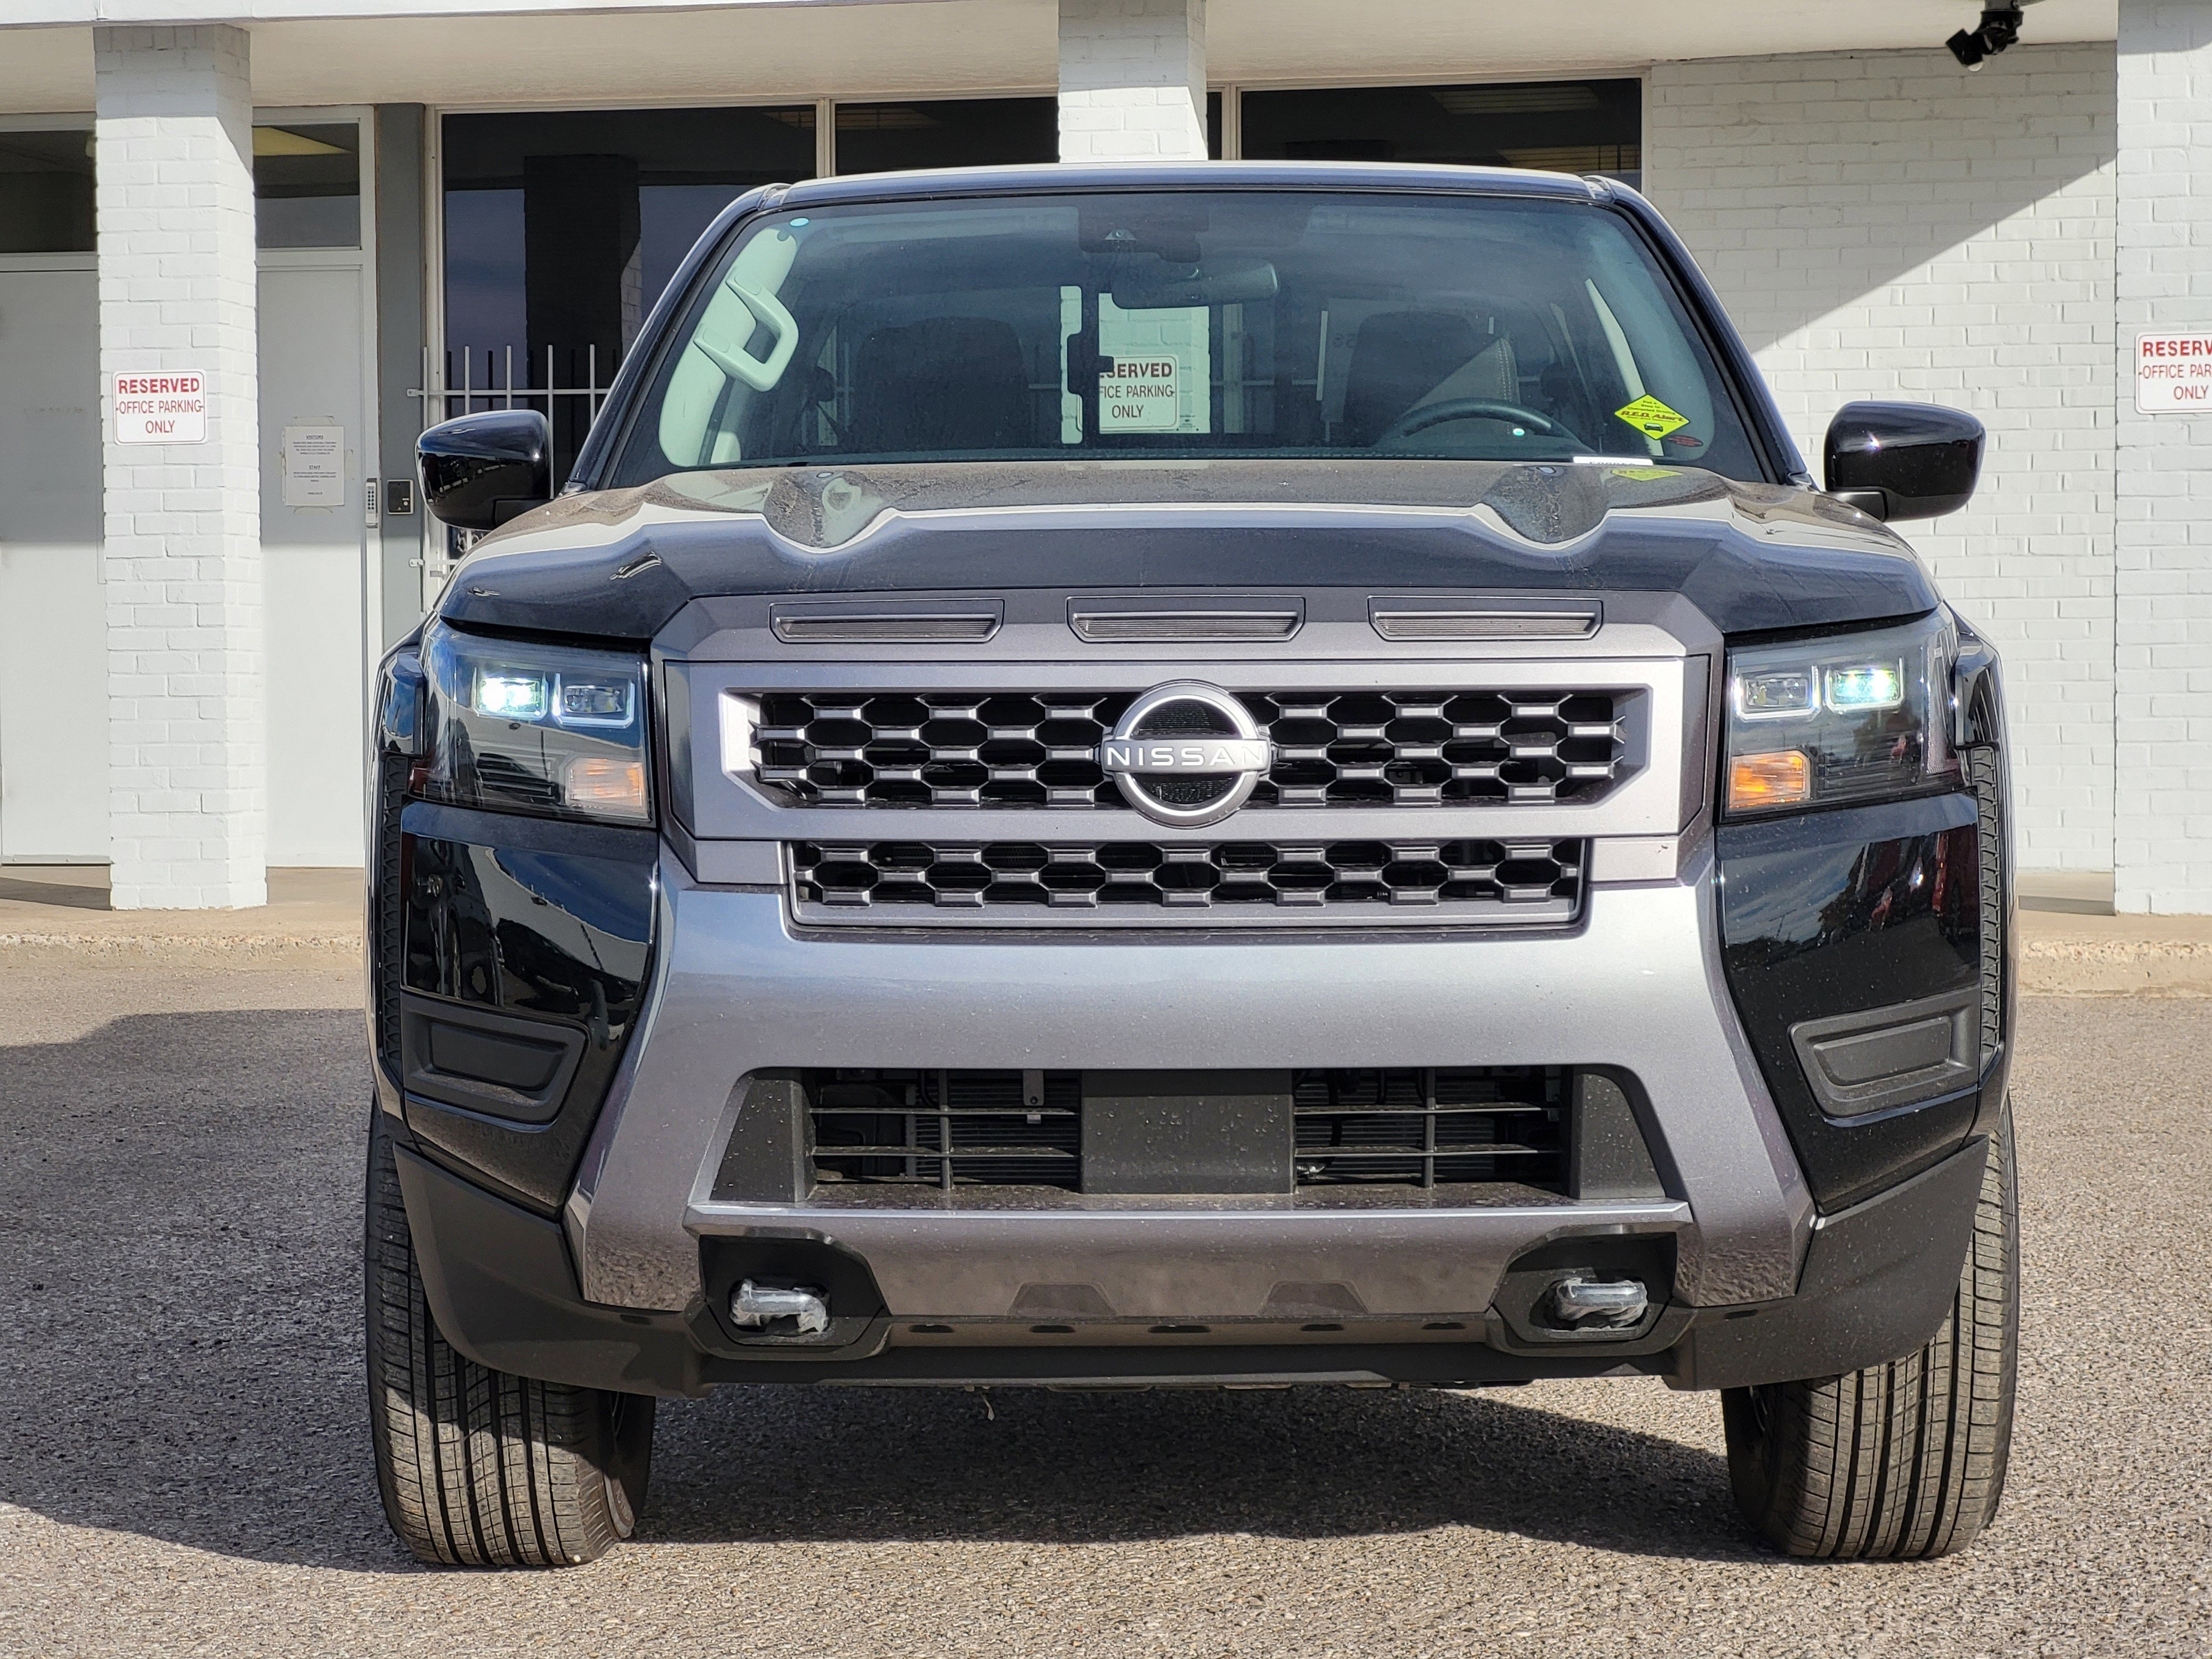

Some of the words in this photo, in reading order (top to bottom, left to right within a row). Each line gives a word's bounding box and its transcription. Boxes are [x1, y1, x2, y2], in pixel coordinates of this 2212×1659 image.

[2143, 340, 2212, 357] RESERV
[1100, 362, 1172, 378] ERVED
[2143, 364, 2184, 379] OFFICE
[118, 378, 200, 394] RESERVED
[1100, 385, 1121, 398] ICE
[1126, 384, 1173, 398] PARKING
[2174, 385, 2209, 400] ONLY
[119, 401, 154, 414] OFFICE
[159, 399, 202, 413] PARKING
[1112, 404, 1144, 418] ONLY
[145, 420, 175, 434] ONLY
[1107, 746, 1263, 766] NISSAN
